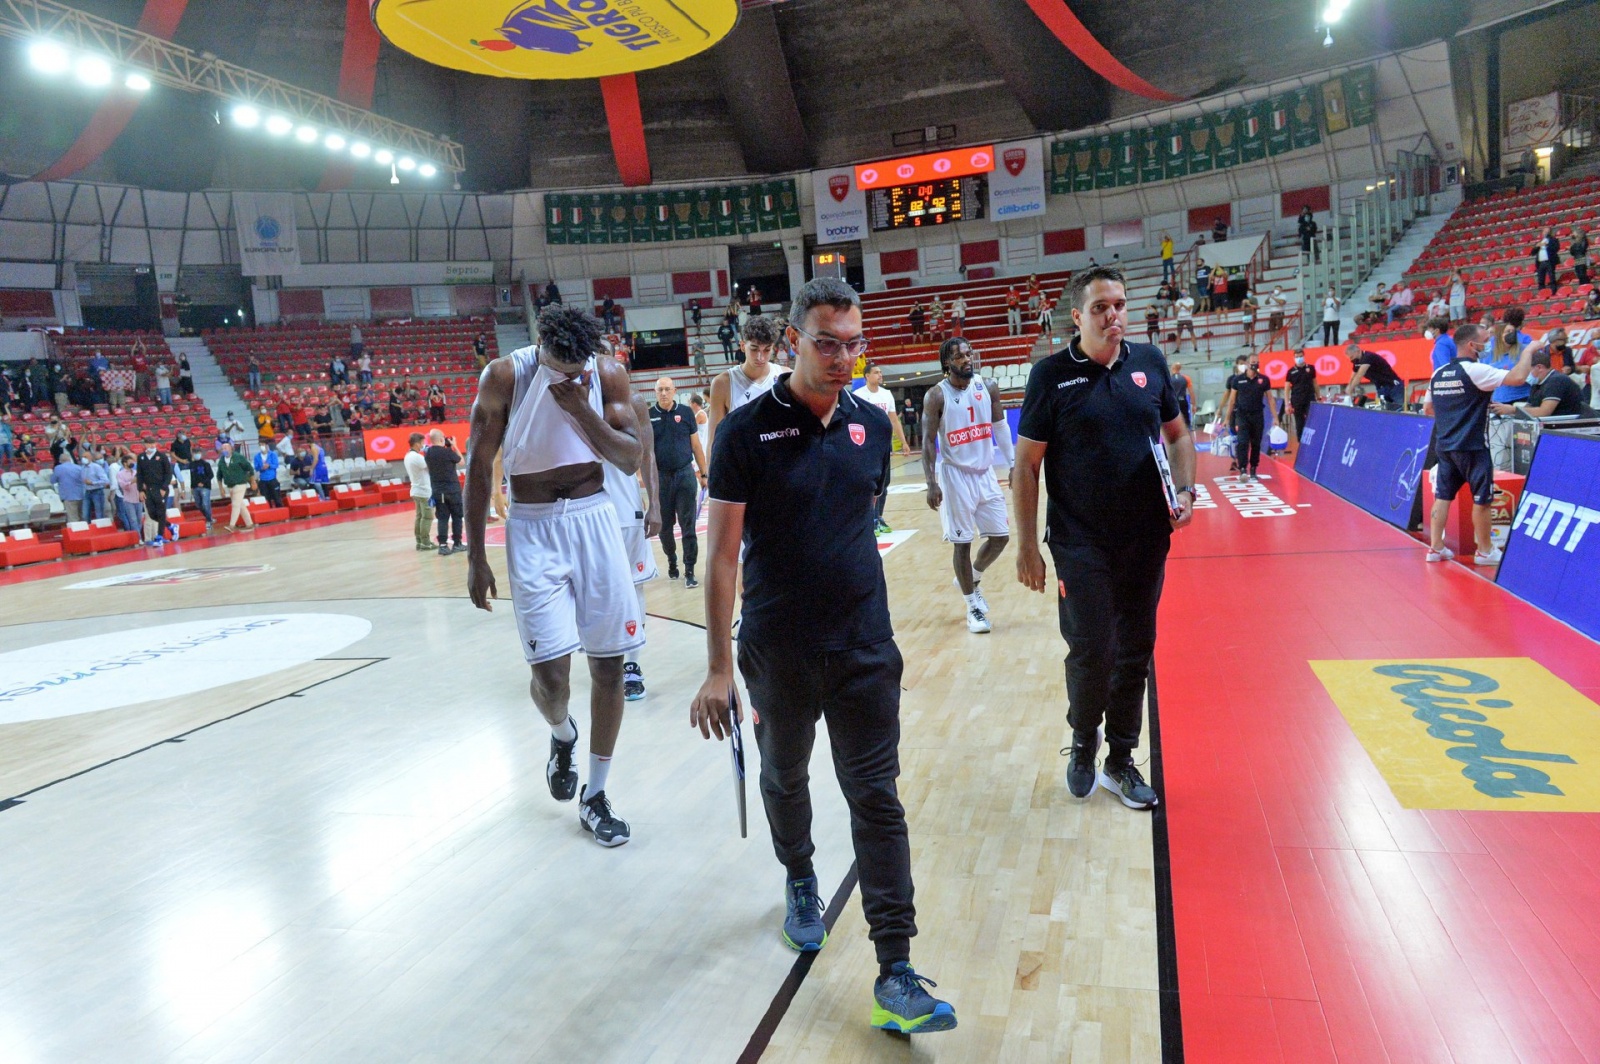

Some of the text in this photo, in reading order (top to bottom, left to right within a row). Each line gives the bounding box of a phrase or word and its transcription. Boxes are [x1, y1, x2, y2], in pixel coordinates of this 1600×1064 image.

[910, 200, 924, 211] 82
[932, 196, 946, 208] 92
[997, 202, 1041, 215] cimberio
[914, 216, 921, 226] 5
[936, 214, 943, 224] 5
[826, 225, 860, 236] brother
[1057, 376, 1090, 389] macron
[966, 406, 975, 423] 1
[760, 427, 800, 442] macron
[1511, 490, 1600, 554] ANT
[1372, 664, 1579, 799] Ricola
